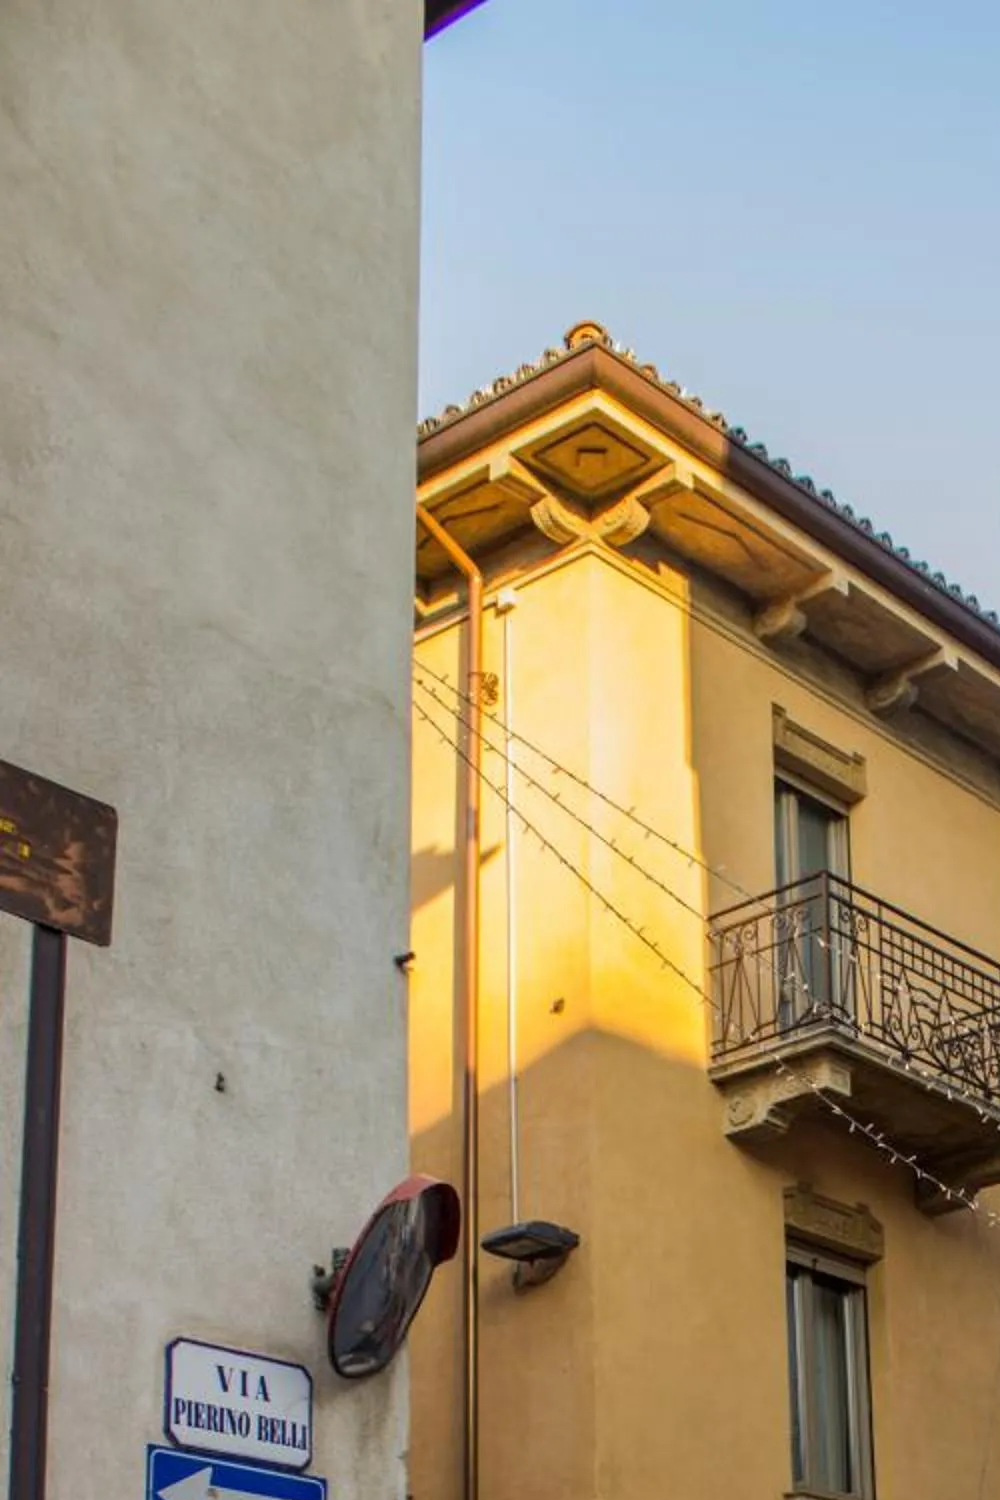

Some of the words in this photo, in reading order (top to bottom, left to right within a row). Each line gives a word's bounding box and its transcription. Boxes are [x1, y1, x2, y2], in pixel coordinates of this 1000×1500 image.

[217, 1365, 271, 1403] VIA
[173, 1397, 251, 1438] PIERINO
[257, 1414, 307, 1450] BELLI
